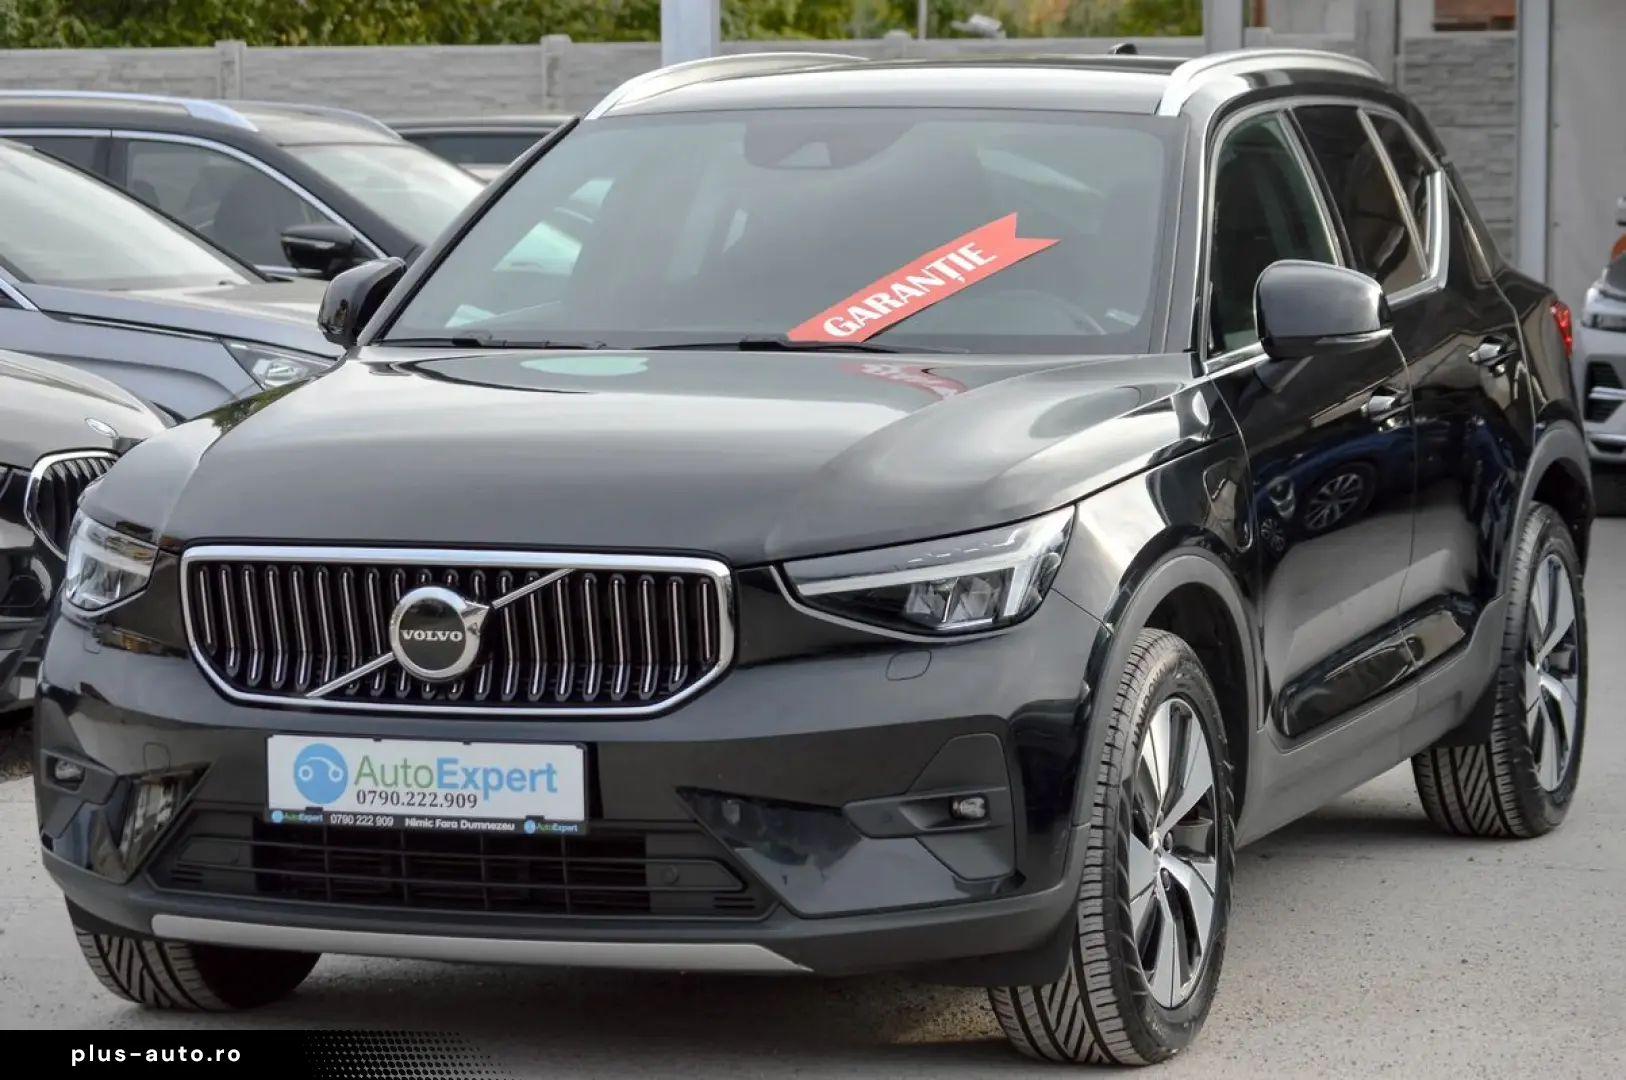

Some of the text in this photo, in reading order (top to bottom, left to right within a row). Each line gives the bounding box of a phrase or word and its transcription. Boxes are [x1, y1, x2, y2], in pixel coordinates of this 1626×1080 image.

[400, 630, 463, 642] VOLVO
[354, 755, 558, 799] AutoExpert
[356, 789, 478, 808] 0790.222.909
[356, 815, 374, 826] 222
[375, 816, 394, 827] 909
[405, 817, 434, 828] Nimic
[435, 819, 458, 829] Fara
